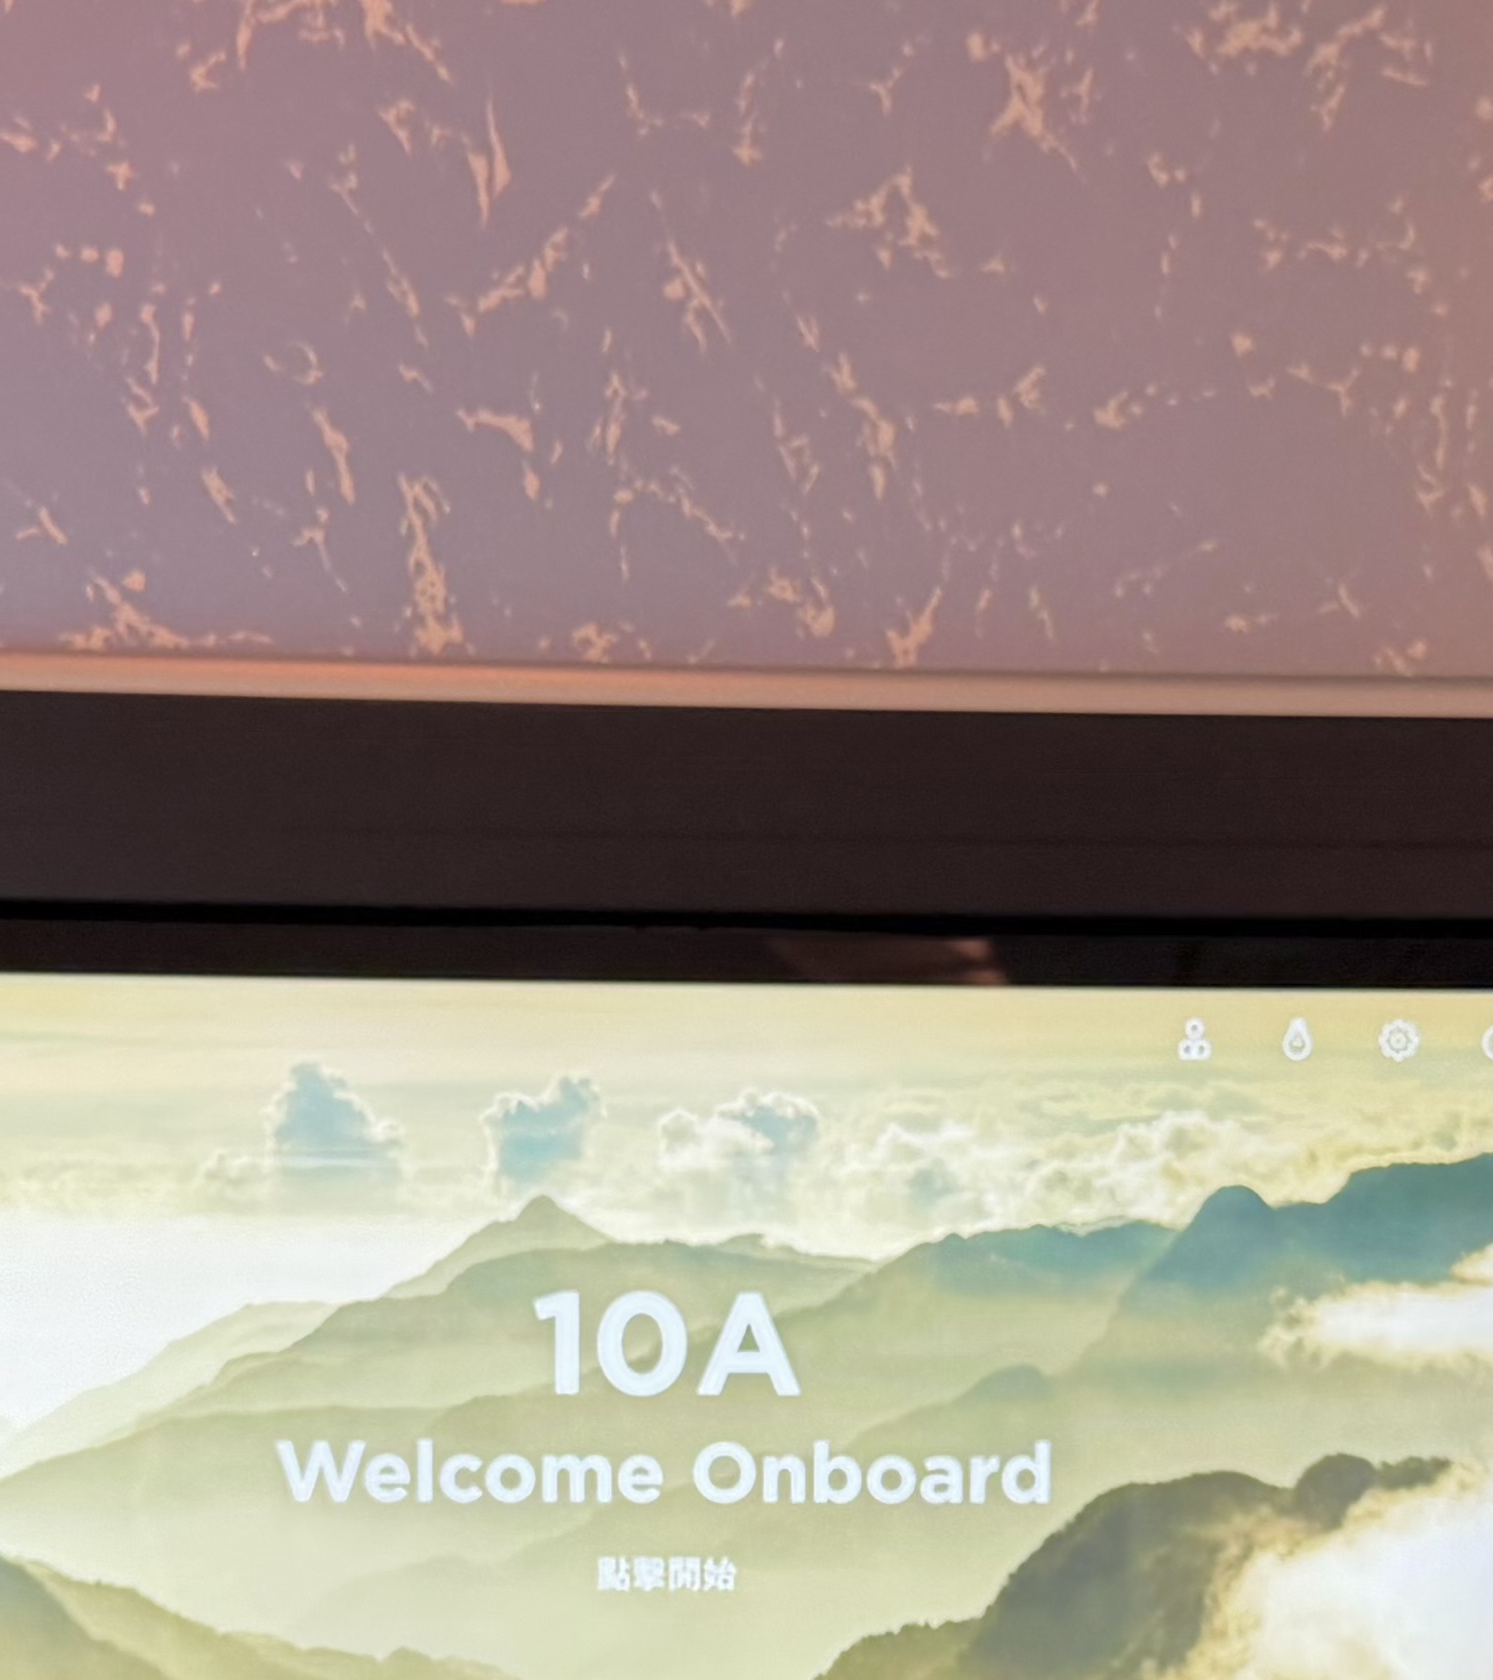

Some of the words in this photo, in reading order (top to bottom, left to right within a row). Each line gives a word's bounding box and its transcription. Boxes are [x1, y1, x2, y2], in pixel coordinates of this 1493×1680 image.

[535, 1290, 801, 1398] 10A
[276, 1438, 664, 1505] Welcome
[692, 1440, 1053, 1505] Onboard
